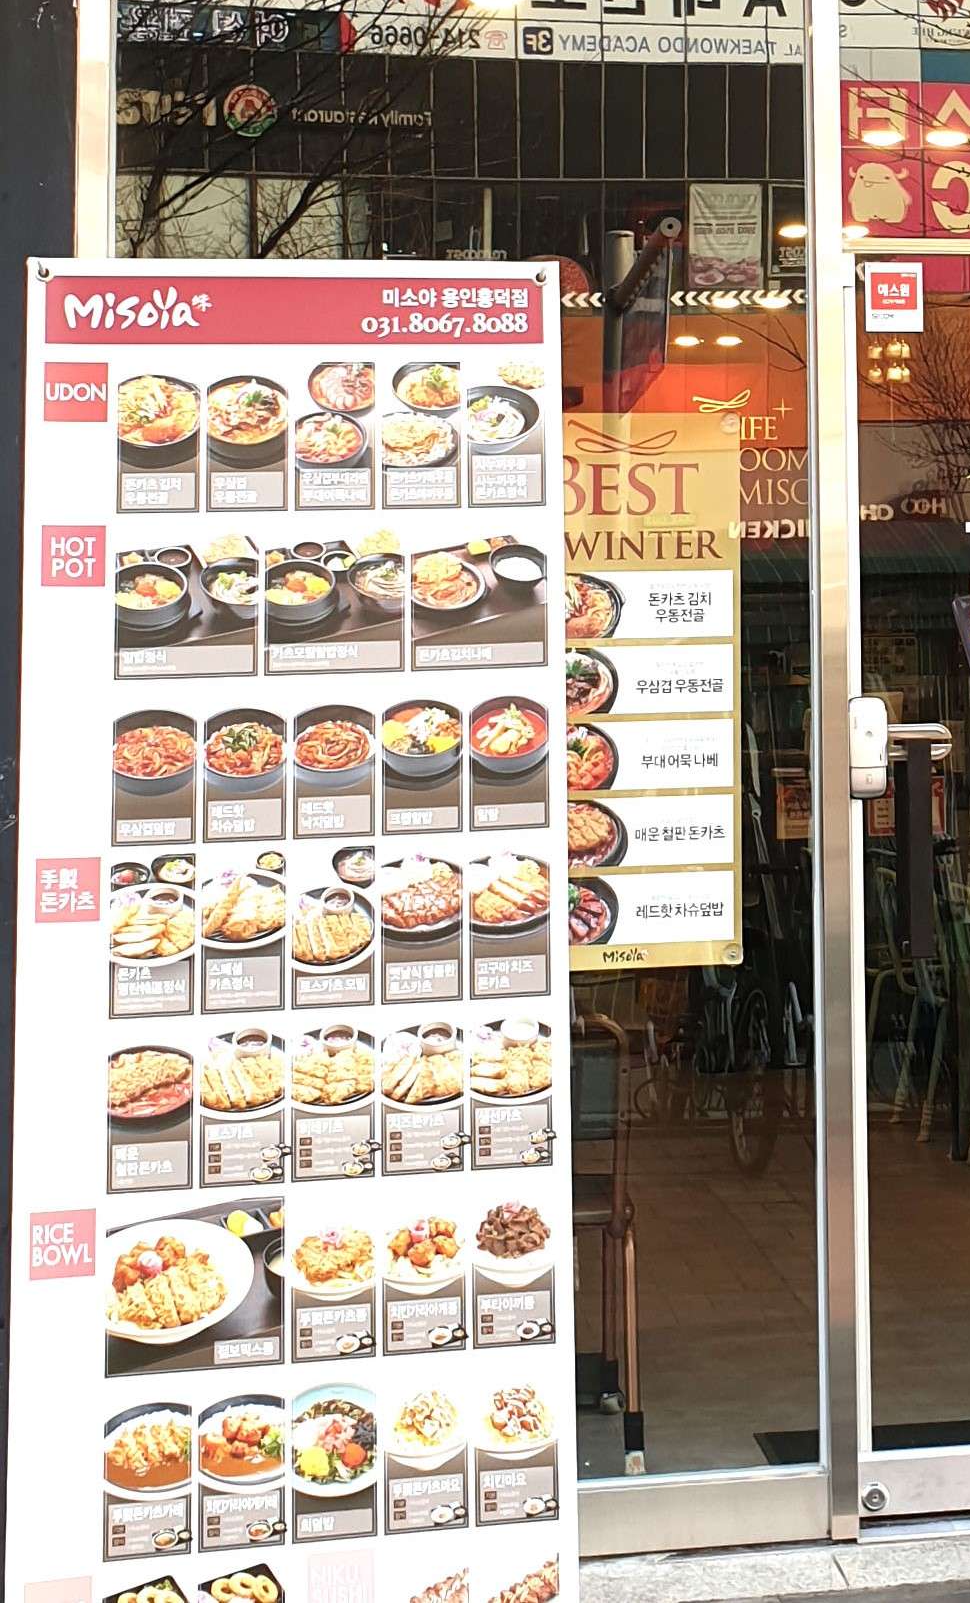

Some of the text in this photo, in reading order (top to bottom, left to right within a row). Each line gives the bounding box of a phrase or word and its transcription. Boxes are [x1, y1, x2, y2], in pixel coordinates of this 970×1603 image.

[382, 287, 529, 309] 미소야 용인흥덕점
[361, 312, 529, 338] 031.8067.8088
[46, 381, 107, 403] UDON
[563, 455, 700, 517] BEST
[50, 537, 96, 557] HOT
[565, 529, 723, 561] WINTER
[51, 558, 96, 579] POT
[648, 591, 712, 607] 돈카츠 김치
[655, 607, 706, 623] 우동전골
[636, 678, 723, 695] 우삼겹 우동전골
[641, 754, 666, 769] 부대
[694, 753, 719, 768] 나베
[635, 826, 726, 842] 매운 철판 돈카츠
[40, 890, 96, 913] 돈카츠
[635, 901, 724, 919] 레드핫 차슈덮밥
[32, 1221, 75, 1245] RICE
[32, 1243, 94, 1267] BOWL
